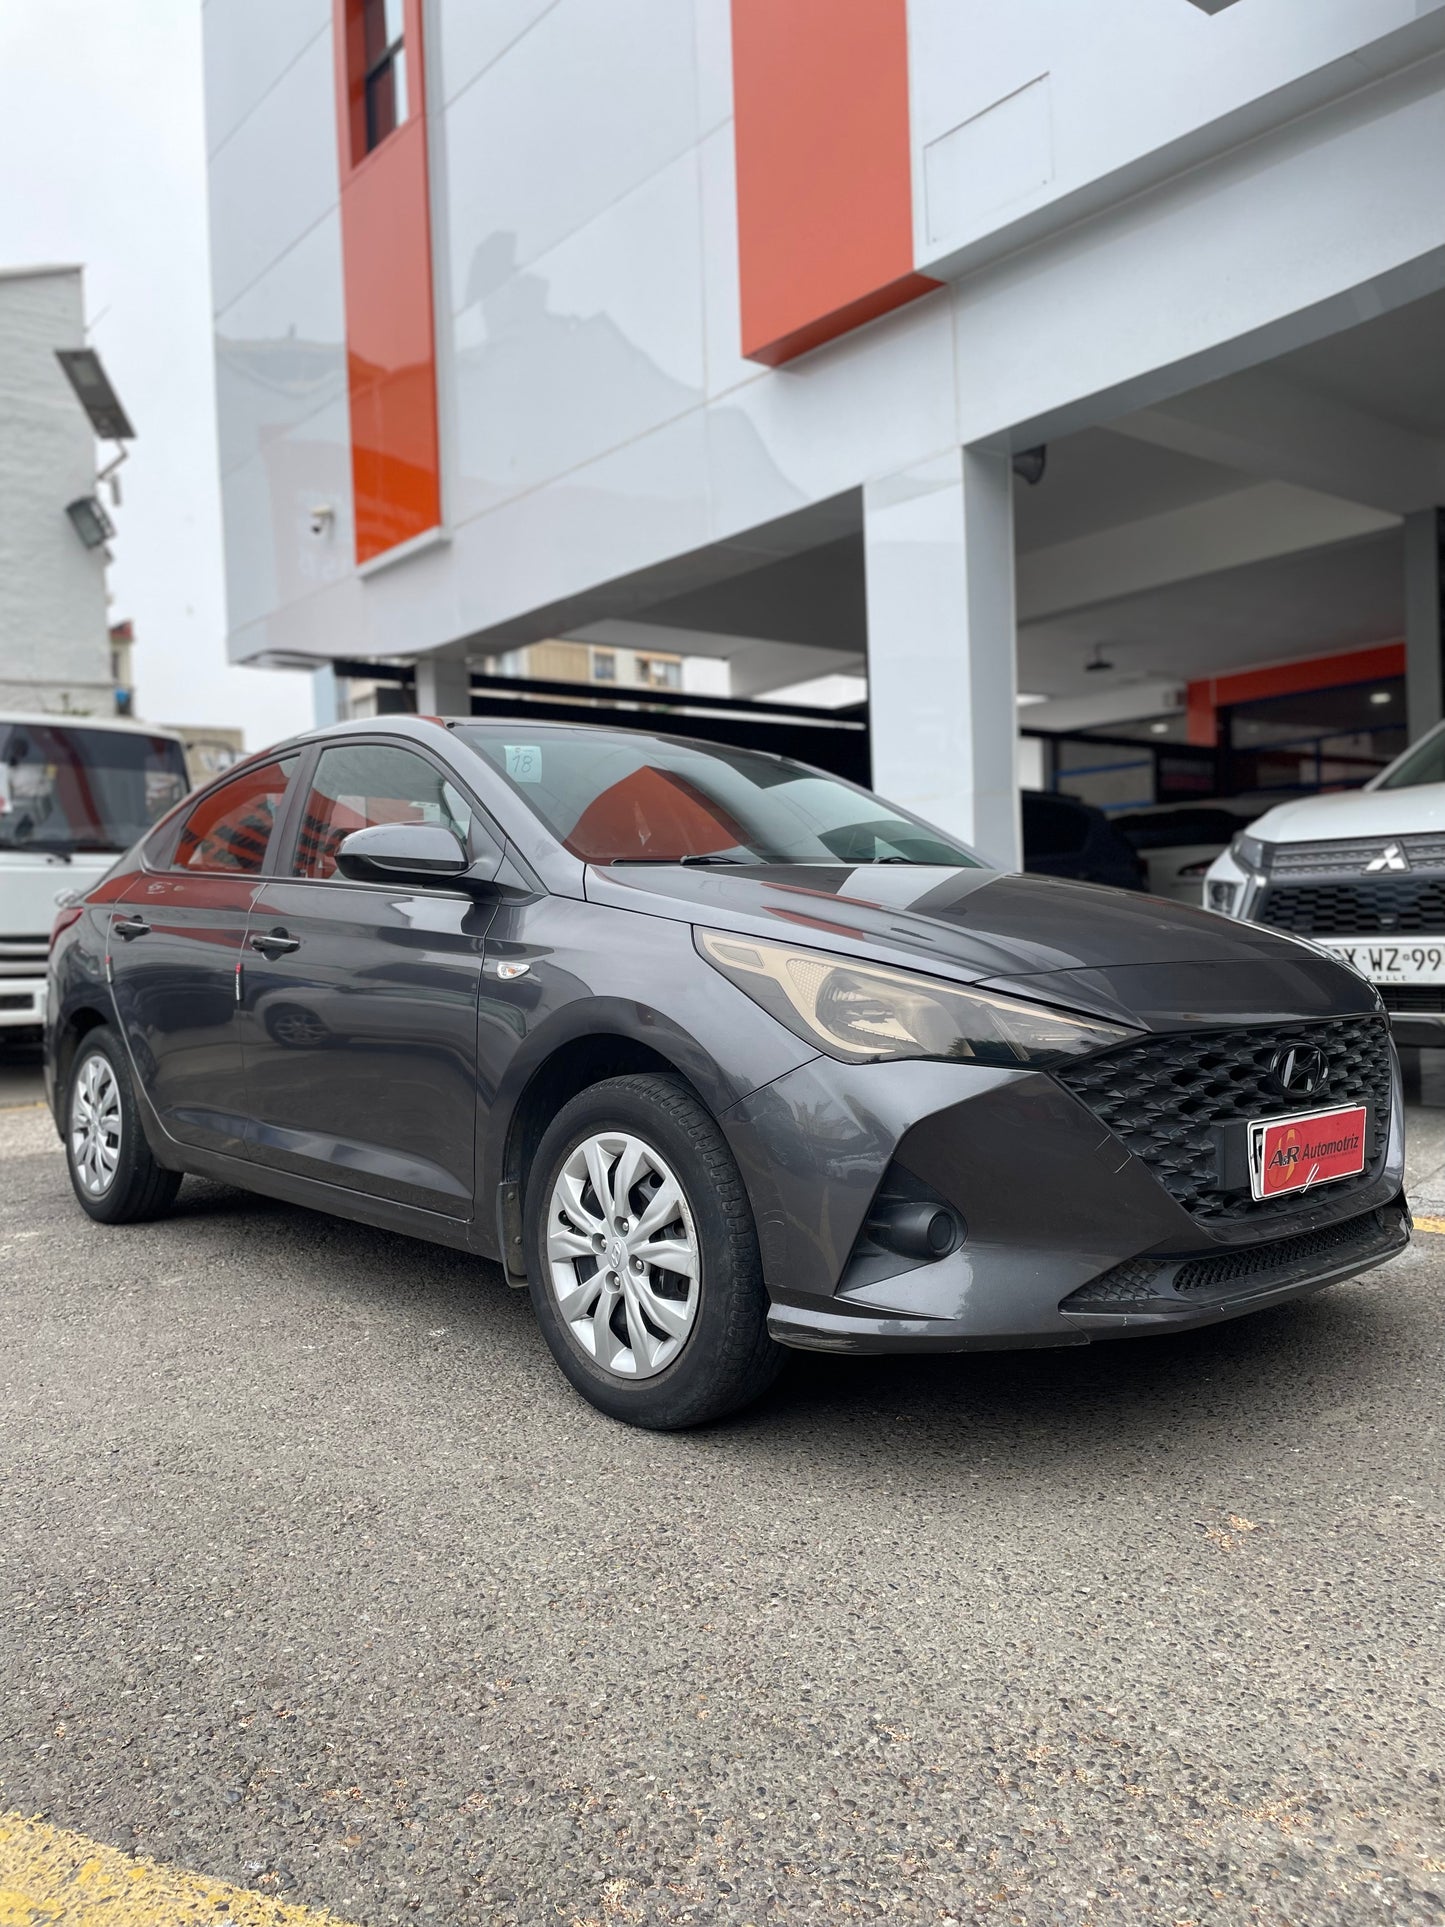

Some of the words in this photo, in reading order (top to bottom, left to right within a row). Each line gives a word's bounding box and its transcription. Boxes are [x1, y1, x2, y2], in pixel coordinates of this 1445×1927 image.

[512, 755, 533, 773] 18
[1268, 1146, 1300, 1169] A&R
[1302, 1133, 1359, 1160] Automotriz
